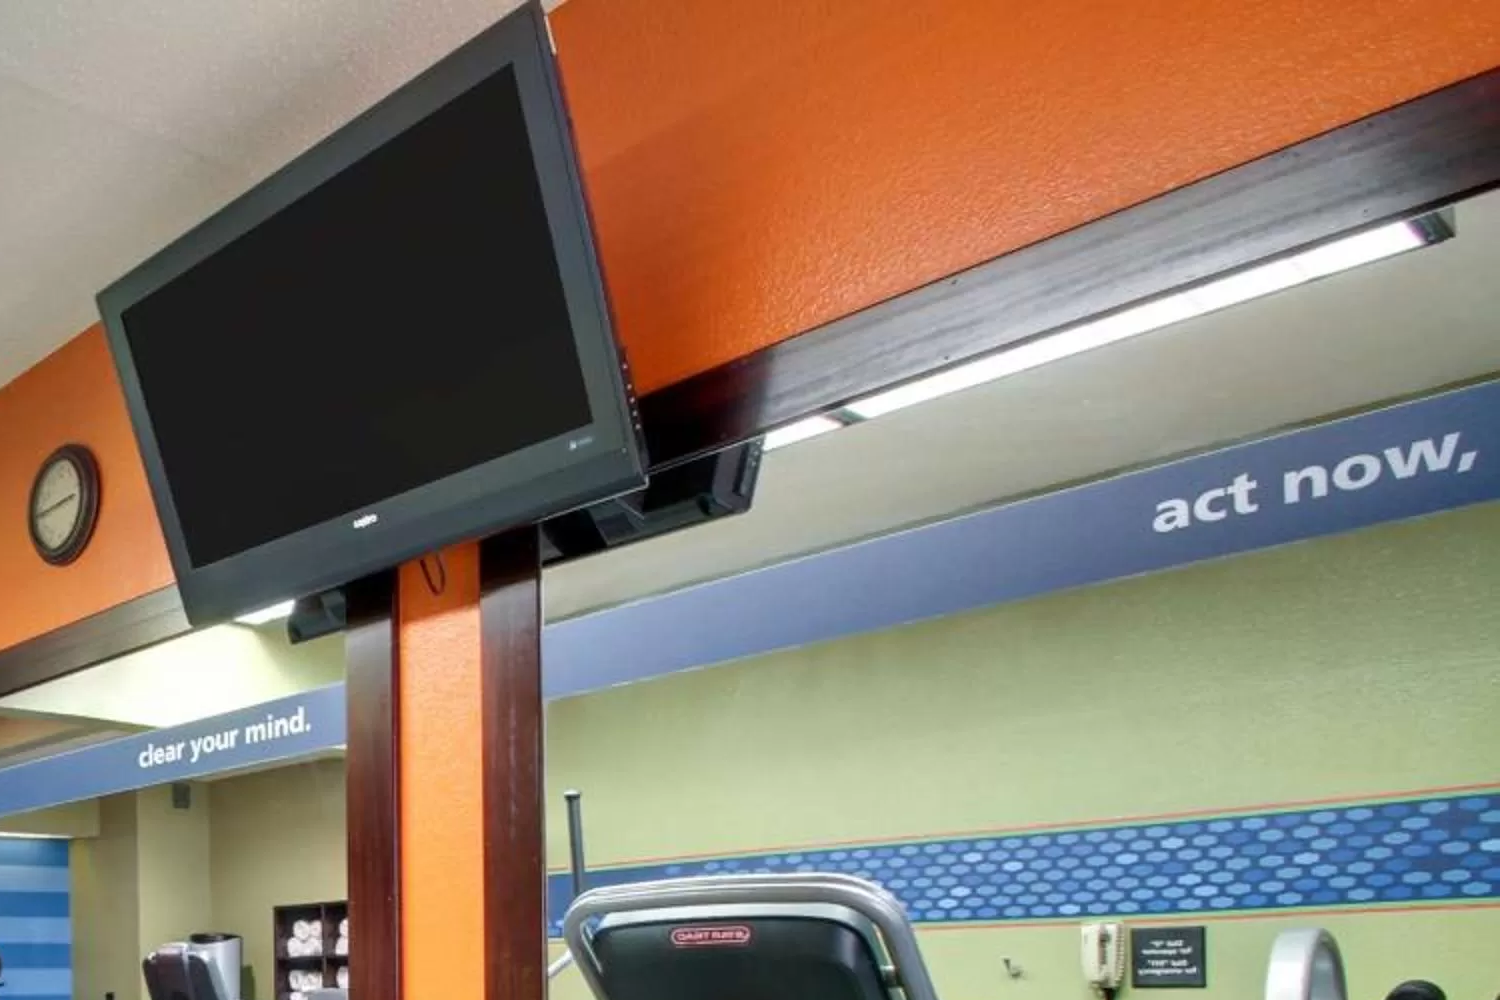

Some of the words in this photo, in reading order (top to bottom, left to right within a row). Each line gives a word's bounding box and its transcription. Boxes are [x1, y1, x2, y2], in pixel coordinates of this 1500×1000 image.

[1152, 473, 1258, 533] act
[1284, 432, 1478, 504] now,
[138, 742, 185, 769] clear
[190, 728, 239, 764] your
[245, 706, 311, 745] mind.
